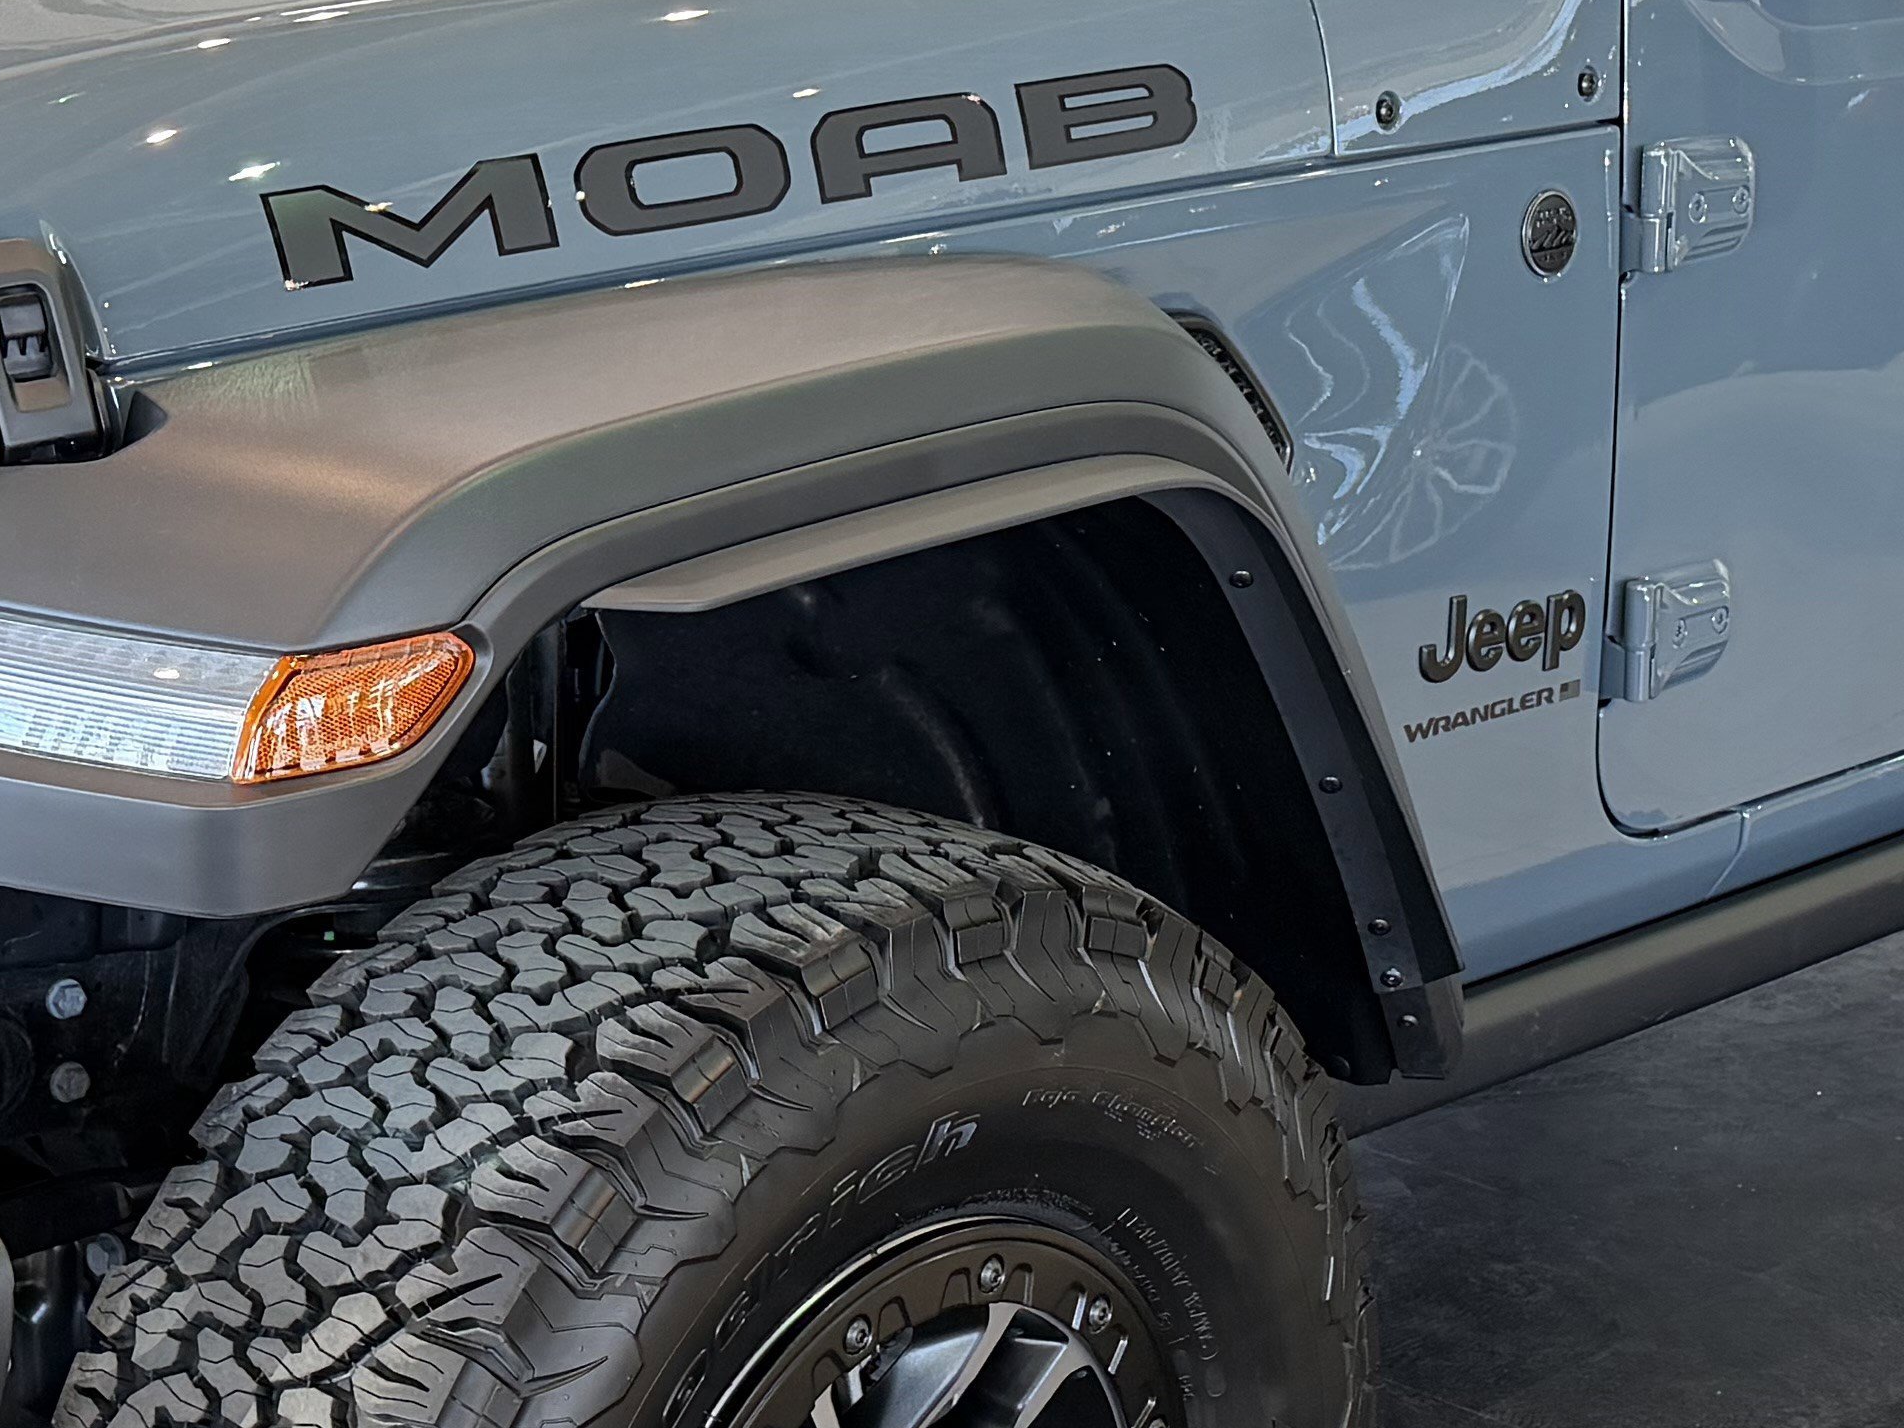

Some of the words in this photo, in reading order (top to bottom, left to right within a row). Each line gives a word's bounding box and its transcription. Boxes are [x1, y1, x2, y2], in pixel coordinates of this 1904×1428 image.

[259, 62, 1199, 291] MOAB
[1418, 588, 1587, 684] Jeep
[1402, 685, 1555, 744] WRANGLER
